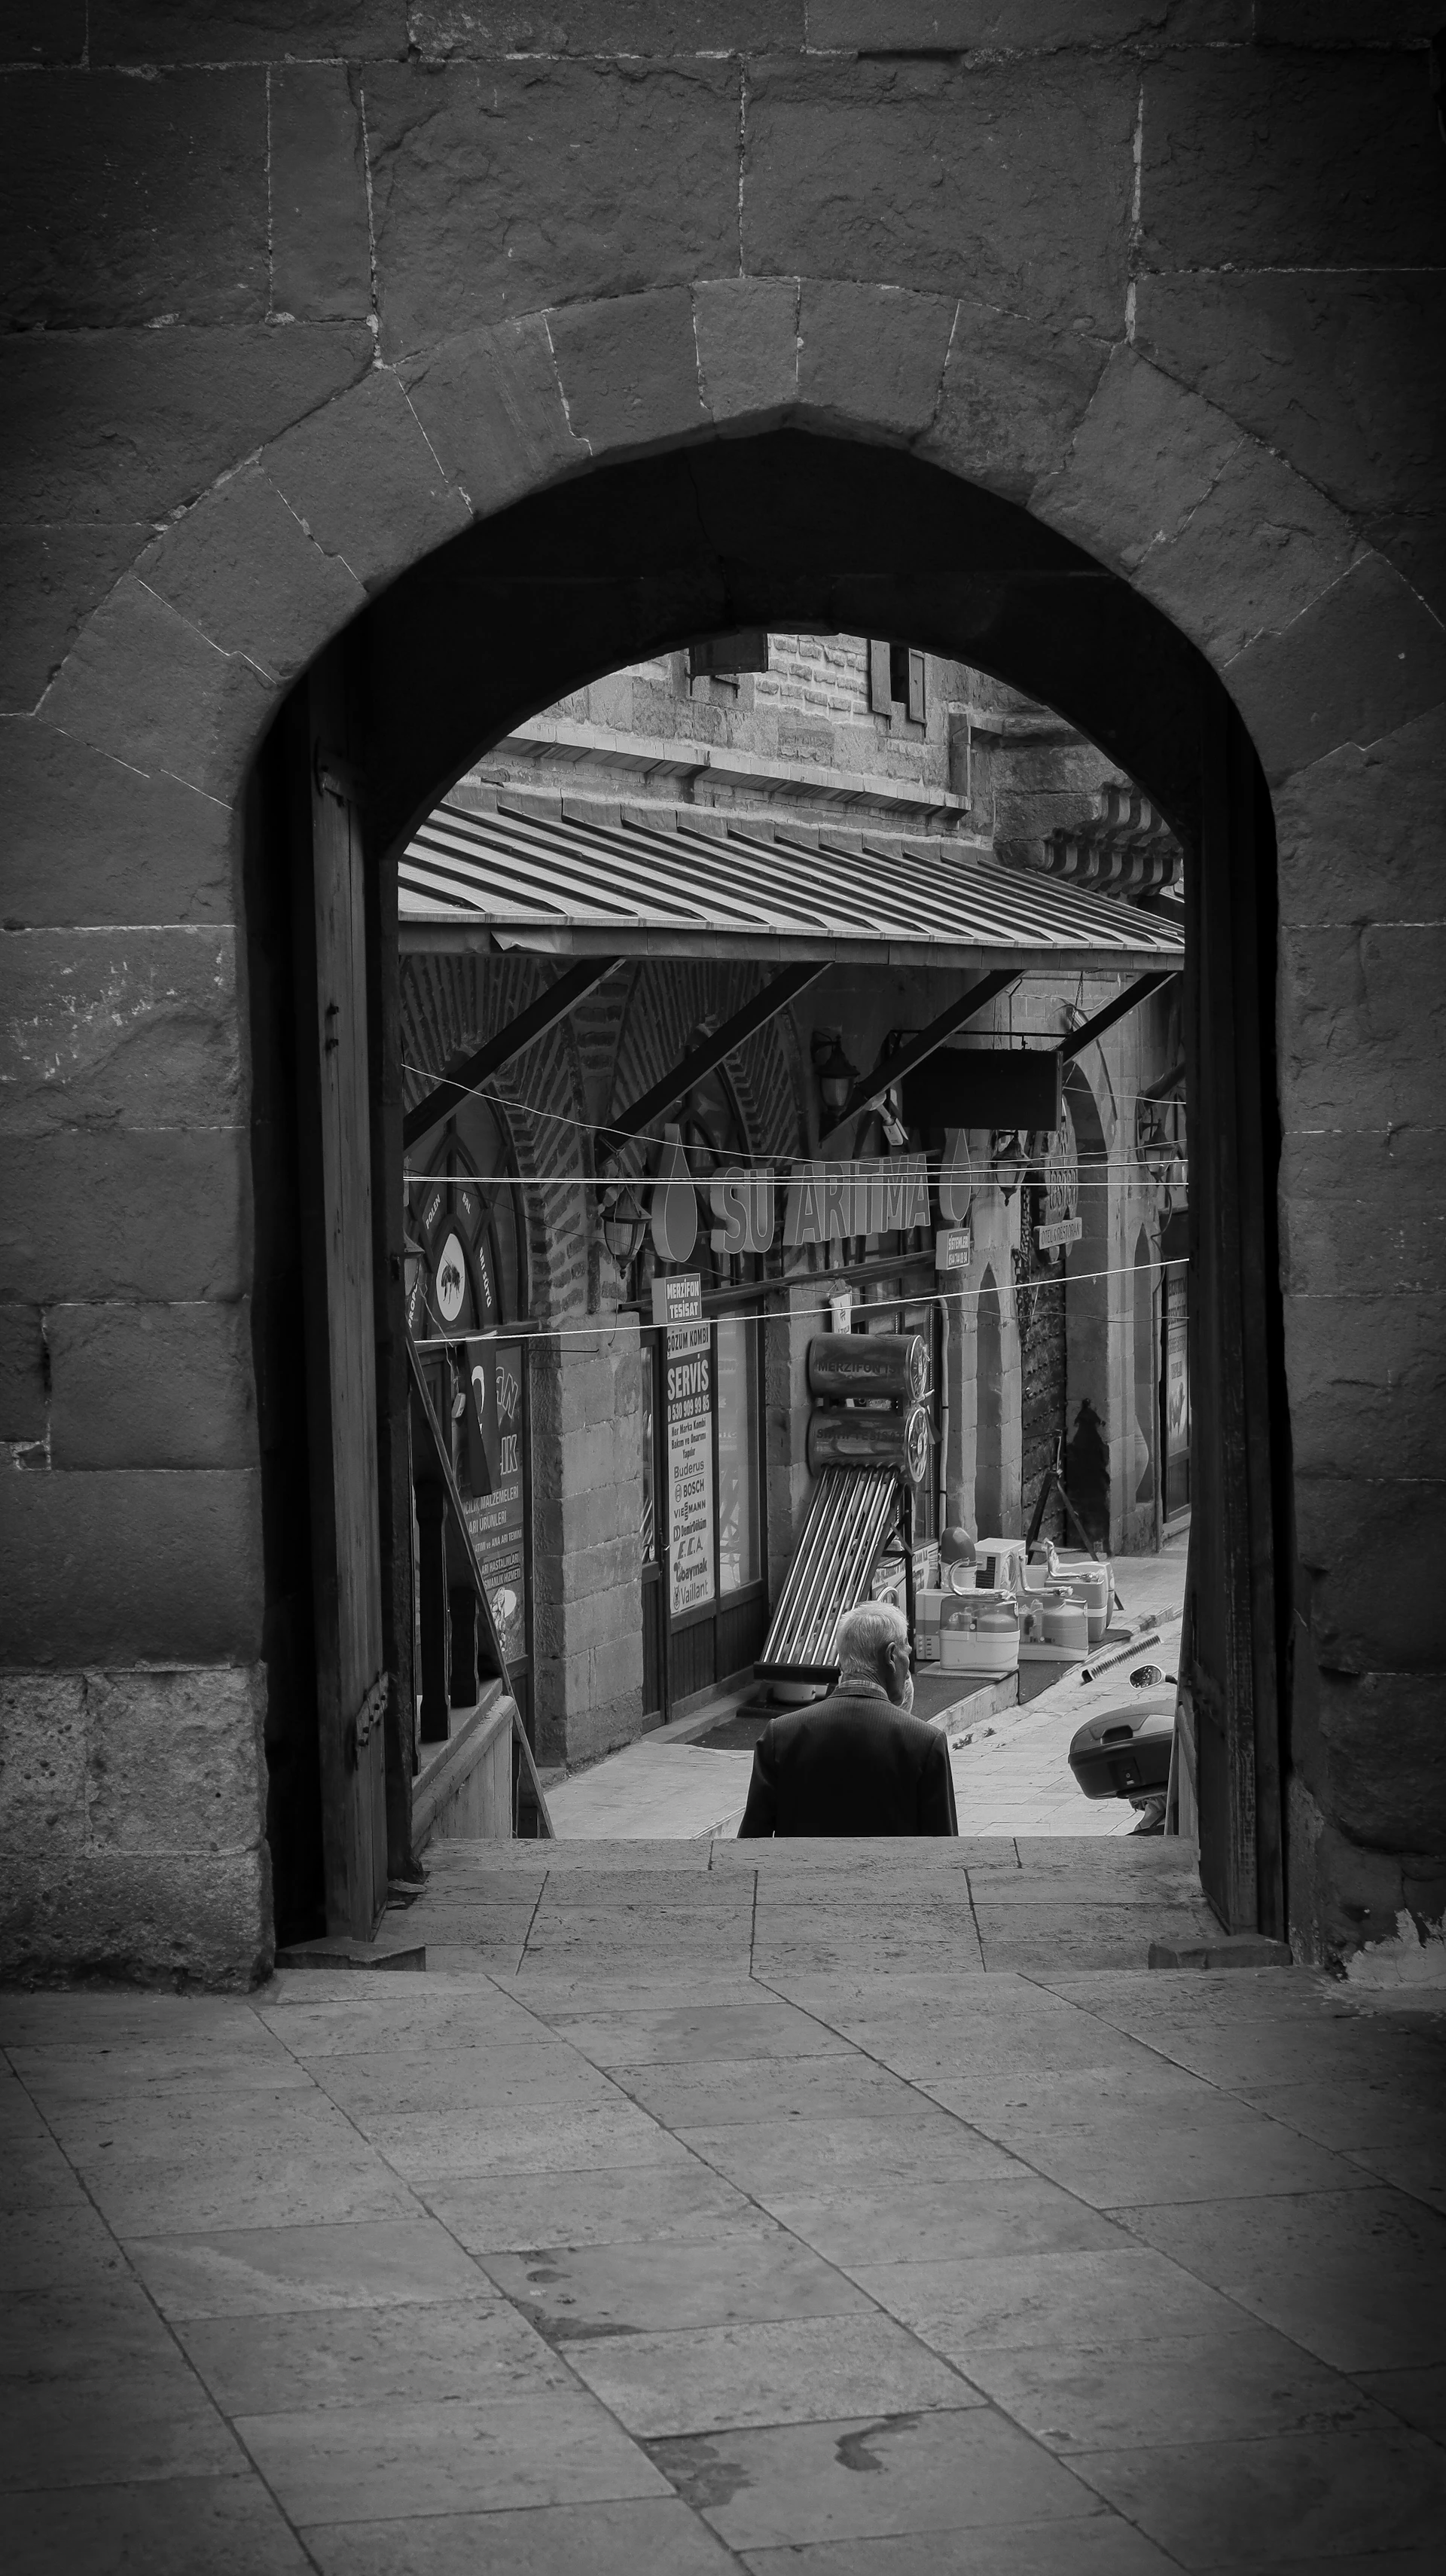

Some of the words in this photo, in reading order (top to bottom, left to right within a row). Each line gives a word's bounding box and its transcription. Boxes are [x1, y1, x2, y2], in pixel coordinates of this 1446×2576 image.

[425, 1193, 441, 1229] POLEN
[462, 1192, 471, 1214] BAL
[721, 1167, 774, 1254] SU
[795, 1154, 931, 1246] ARITMA
[482, 1271, 493, 1308] SÜTÜ
[667, 1277, 700, 1300] MERZİFON
[669, 1299, 698, 1319] TESİSAT
[667, 1329, 688, 1357] ÇÖZÜM
[667, 1354, 709, 1401] SERVİS
[818, 1361, 880, 1373] MERZIFON
[667, 1405, 672, 1422] 0
[672, 1402, 683, 1421] 530
[683, 1399, 694, 1418] 909
[694, 1396, 702, 1415] 99
[702, 1394, 710, 1412] 85
[671, 1426, 679, 1437] Her
[679, 1422, 693, 1435] Marka
[693, 1417, 706, 1430] Kombi
[671, 1439, 685, 1450] Bakım
[685, 1437, 690, 1445] ve
[674, 1460, 704, 1479] Buderus
[480, 1482, 520, 1510] MALZEMELERİ
[683, 1479, 705, 1498] BOSCH
[468, 1520, 478, 1534] ARI
[479, 1506, 507, 1531] ÜRÜNLERİ
[674, 1500, 706, 1521] VIESSMANN
[681, 1518, 707, 1537] DemirDöküm
[473, 1541, 486, 1553] ATIMI
[491, 1536, 501, 1548] ANA
[682, 1557, 708, 1582] baymak
[680, 1579, 709, 1605] Vaillant
